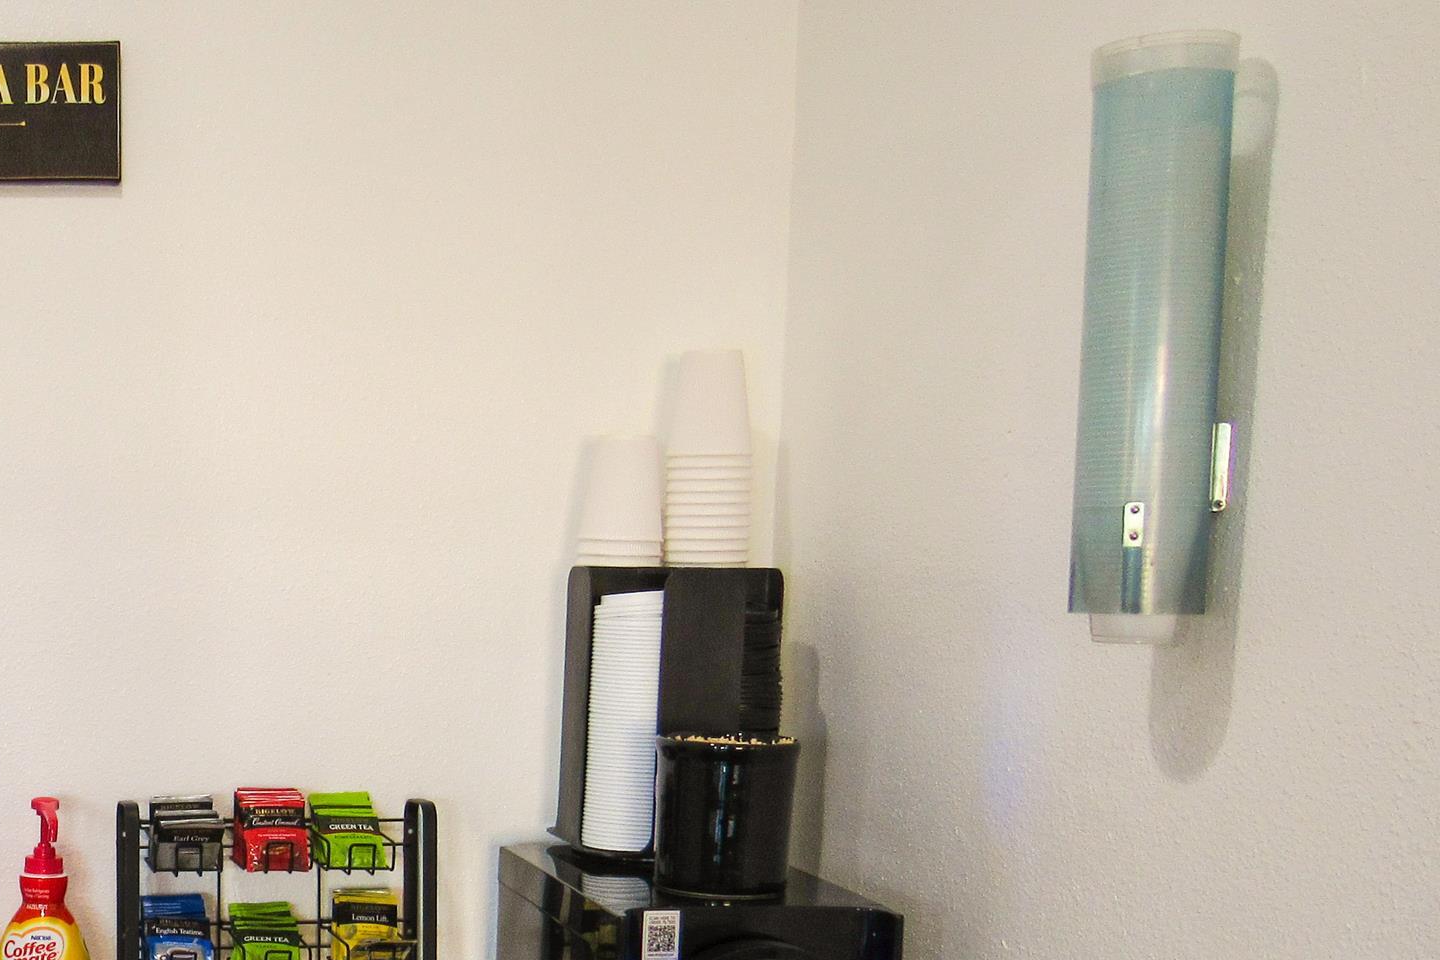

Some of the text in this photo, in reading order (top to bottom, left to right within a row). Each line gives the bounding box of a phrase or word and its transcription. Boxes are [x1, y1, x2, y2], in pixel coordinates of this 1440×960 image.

[24, 62, 106, 105] BAR
[329, 823, 375, 832] GREEN TEA
[352, 913, 375, 921] Lemon
[155, 927, 178, 936] English
[4, 939, 57, 959] Coffee
